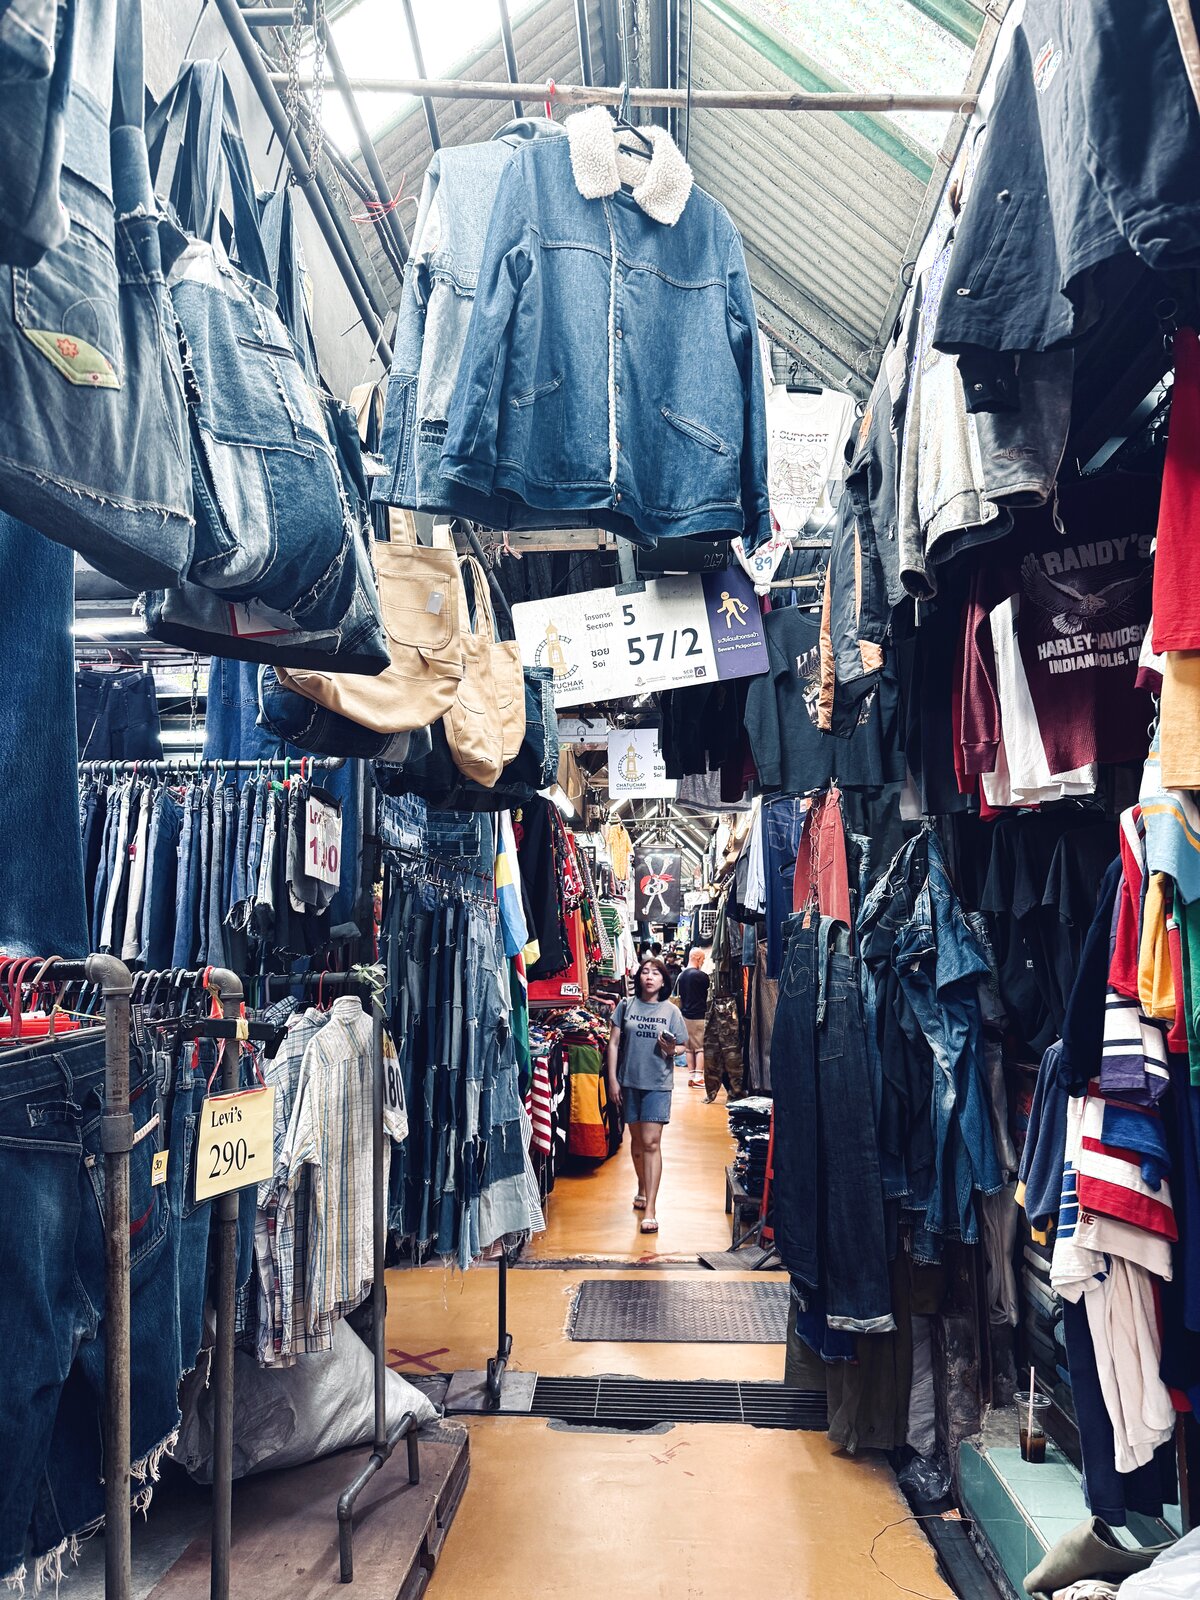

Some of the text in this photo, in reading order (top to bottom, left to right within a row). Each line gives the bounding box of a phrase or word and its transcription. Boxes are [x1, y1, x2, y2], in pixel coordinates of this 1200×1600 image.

[1043, 534, 1154, 575] RANDY'S
[754, 557, 772, 571] 89
[622, 604, 636, 626] 5
[586, 621, 614, 631] Section
[590, 647, 610, 657] ซอย
[627, 627, 703, 666] 57/2
[592, 660, 606, 669] Soi
[553, 679, 584, 689] TUCHAK
[629, 1014, 667, 1025] NUMBER
[636, 1031, 658, 1039] GIRL
[211, 1106, 242, 1128] Levi's
[208, 1138, 255, 1179] 290-
[1079, 1212, 1098, 1225] KE
